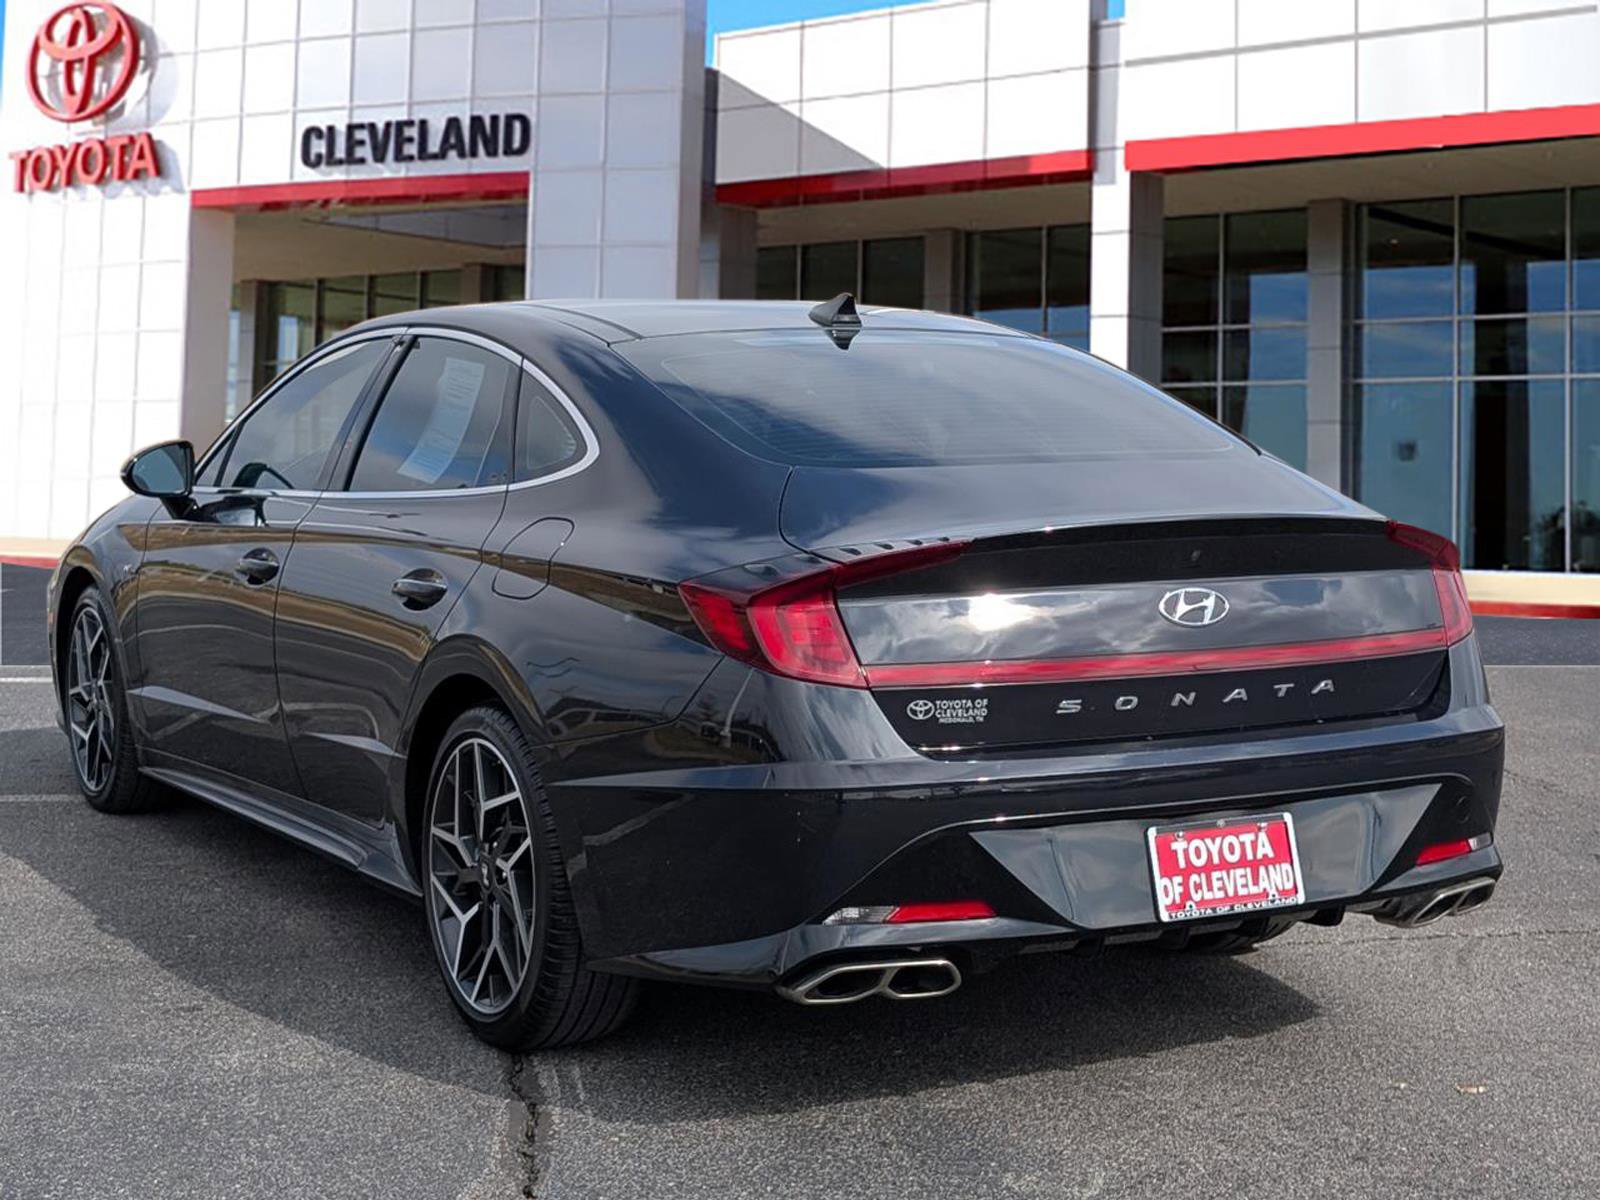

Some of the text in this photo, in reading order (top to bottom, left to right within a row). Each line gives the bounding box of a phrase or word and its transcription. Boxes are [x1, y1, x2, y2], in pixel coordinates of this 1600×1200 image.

[301, 113, 531, 168] CLEVELAND
[9, 132, 160, 193] TOYOTA
[935, 699, 988, 709] TOYOTA OF
[935, 708, 987, 717] CLEVELAND
[1056, 679, 1335, 714] SONATA
[1171, 831, 1275, 869] TOYOTA
[1160, 863, 1294, 905] OF CLEVELAND
[1170, 908, 1213, 919] TOYOTA
